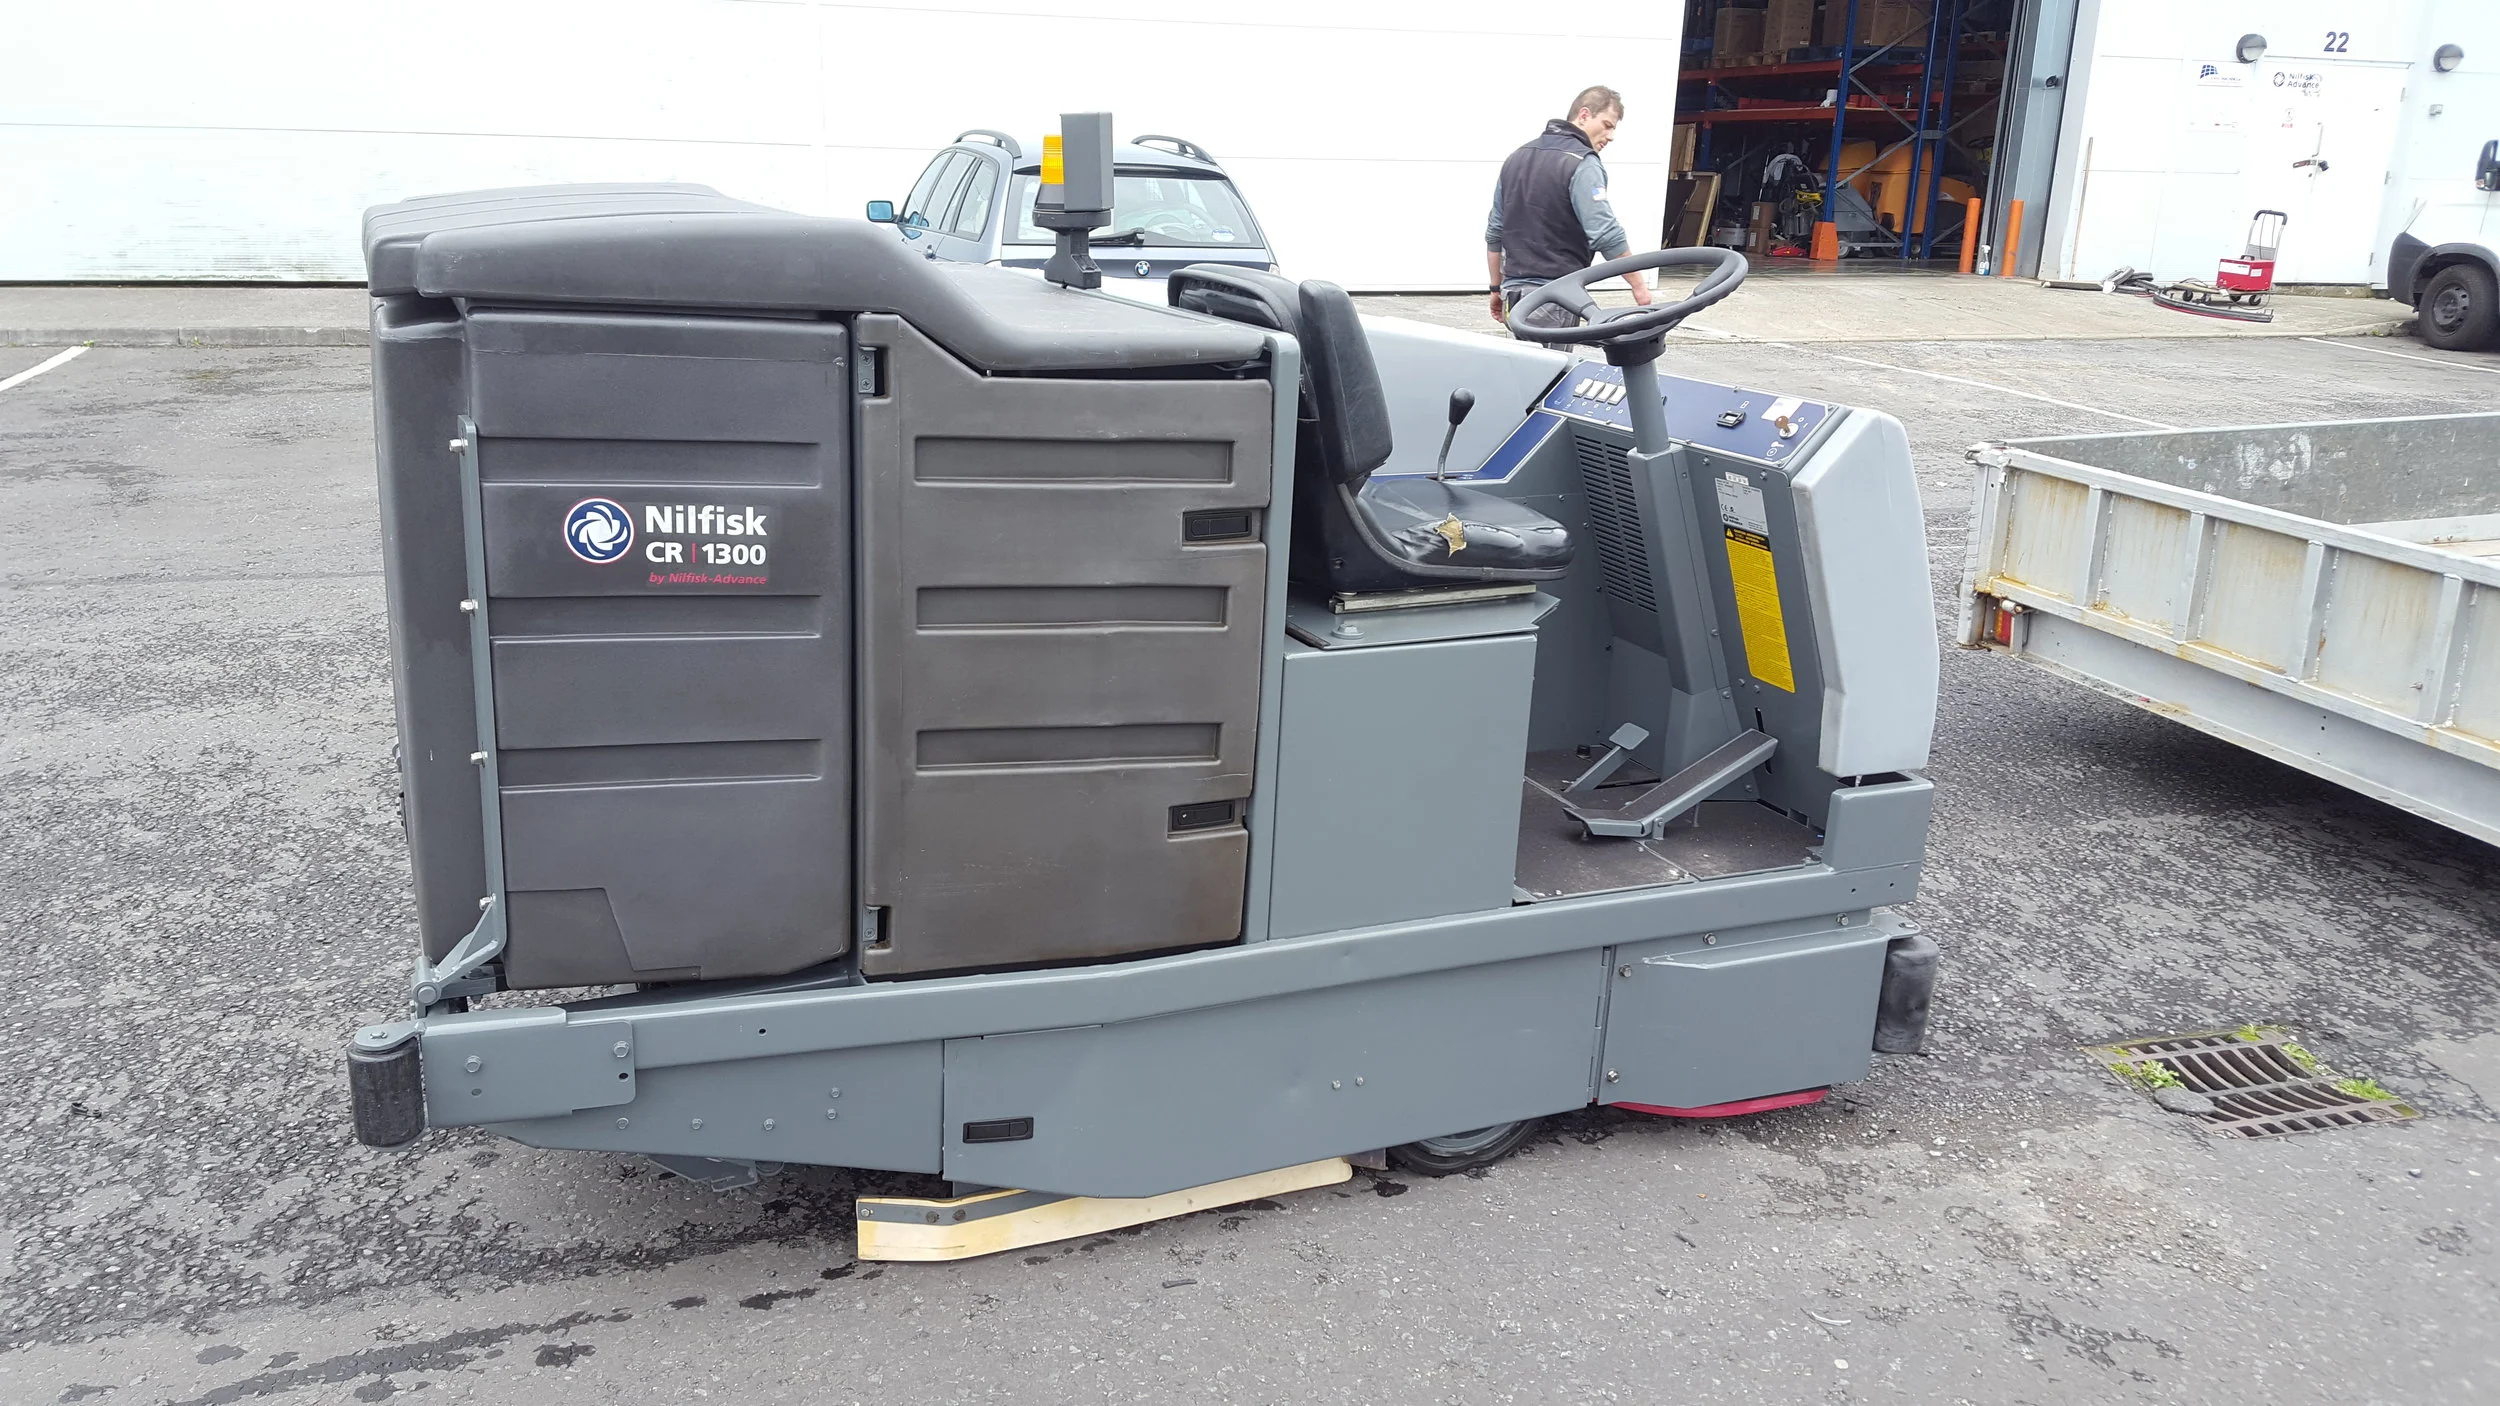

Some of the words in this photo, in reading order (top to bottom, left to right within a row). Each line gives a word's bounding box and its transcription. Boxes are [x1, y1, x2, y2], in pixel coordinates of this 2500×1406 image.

[2323, 31, 2349, 52] 22
[2287, 80, 2320, 89] Advance
[2288, 73, 2314, 81] Nilfisk
[645, 504, 767, 536] Nilfisk
[645, 541, 683, 563] CR
[701, 543, 767, 565] 1300
[649, 572, 665, 585] by
[669, 572, 767, 585] Nilfisk-Advance
